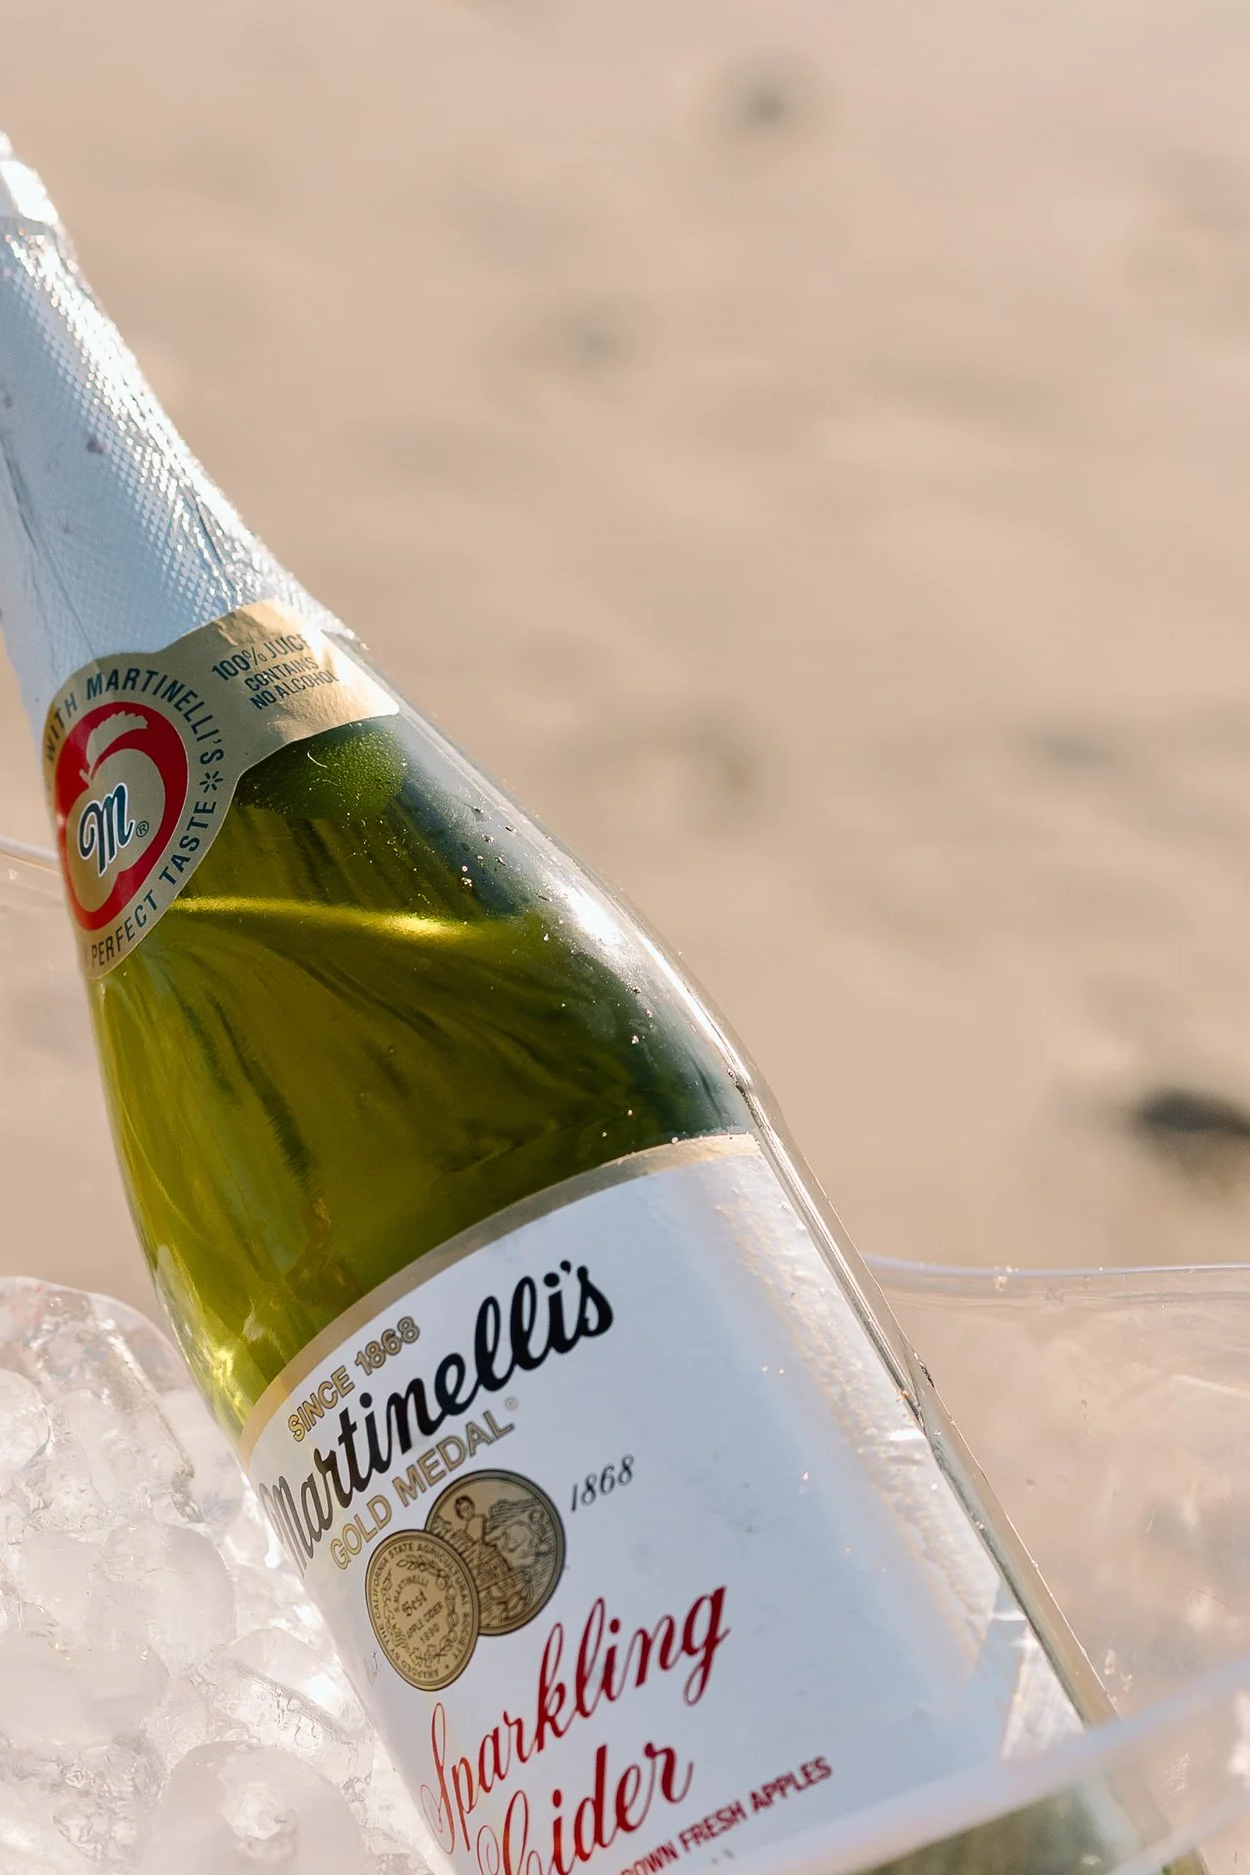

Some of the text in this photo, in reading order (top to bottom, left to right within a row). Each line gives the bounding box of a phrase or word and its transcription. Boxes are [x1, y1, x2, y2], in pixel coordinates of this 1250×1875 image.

[212, 646, 268, 681] 100%
[244, 656, 319, 692] CONTAINS
[249, 689, 278, 711] NO
[85, 667, 225, 766] MARTINELLI'S
[91, 801, 217, 970] PERFECT TASTE
[258, 1259, 614, 1580] Martinelli's
[287, 1315, 421, 1443] SINCE 1868
[329, 1409, 516, 1571] GOLD MEDAL
[570, 1454, 635, 1512] 1868
[419, 1585, 732, 1855] Sparkling
[678, 1800, 749, 1853] FRESH
[749, 1755, 834, 1814] APPLES
